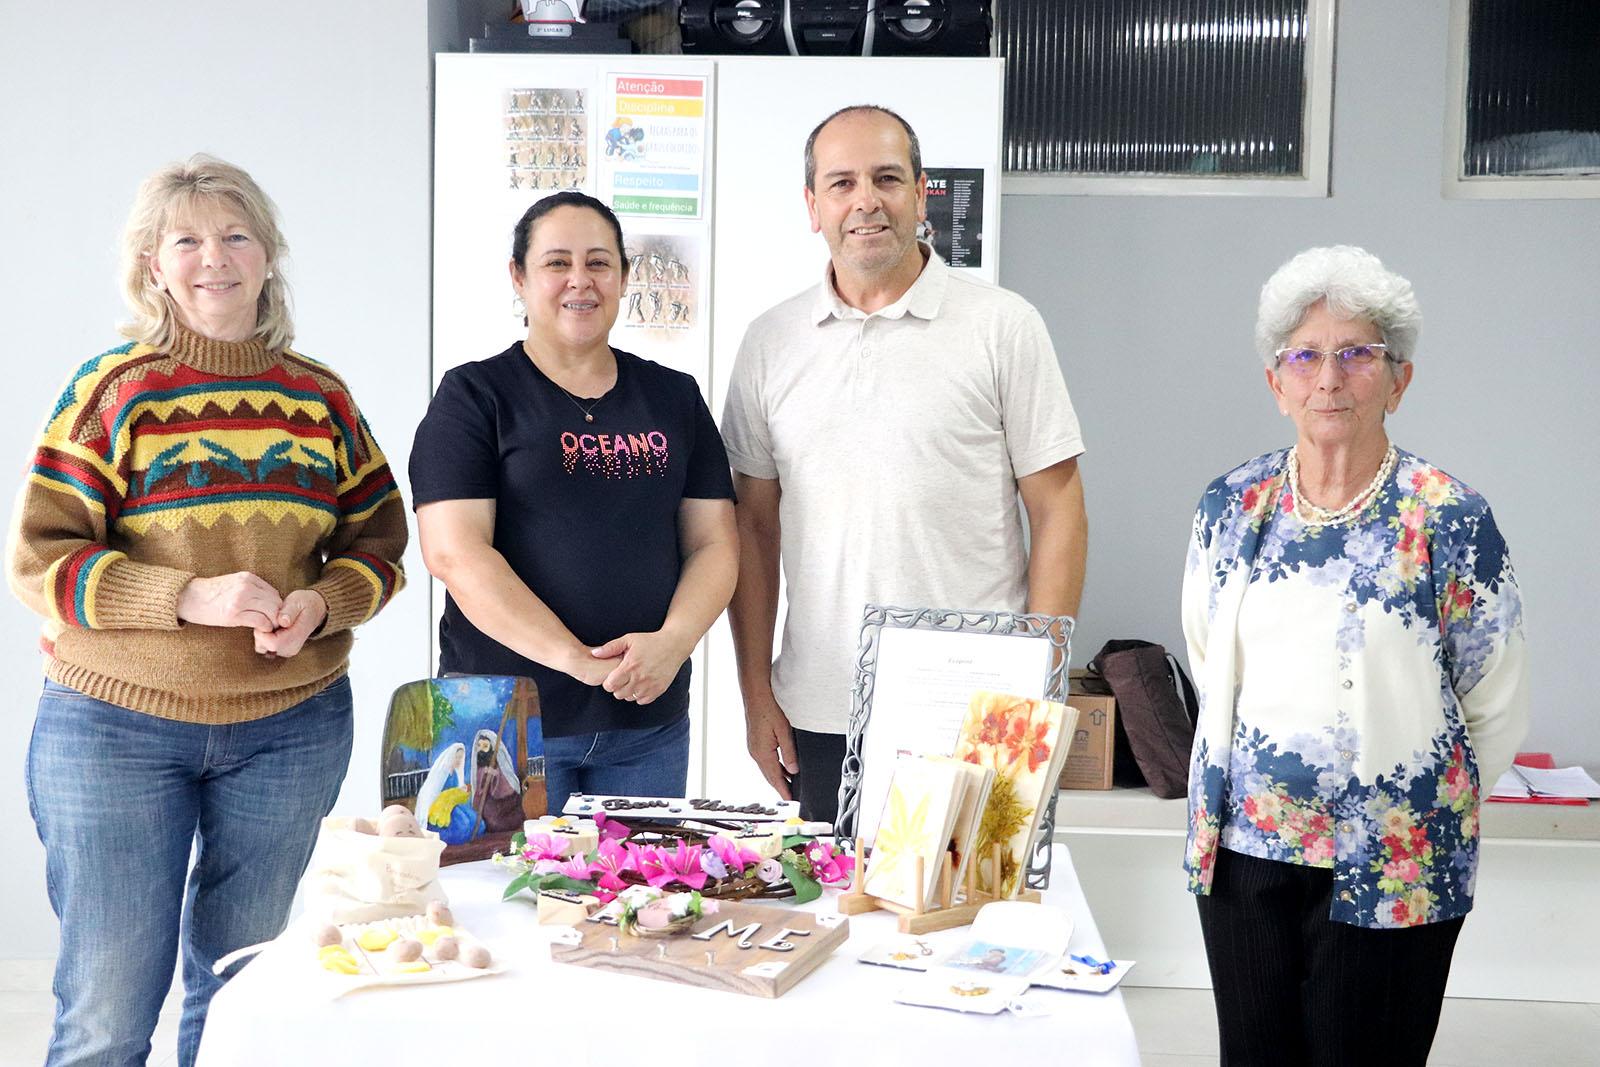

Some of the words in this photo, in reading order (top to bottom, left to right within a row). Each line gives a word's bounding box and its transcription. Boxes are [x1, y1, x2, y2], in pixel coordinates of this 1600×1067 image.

[616, 81, 665, 94] Atenção
[619, 100, 675, 114] Disciplina
[615, 175, 664, 189] Respeito
[926, 179, 947, 189] ATE
[614, 200, 640, 209] Saúde
[648, 202, 693, 213] frequência
[560, 431, 668, 457] OCEANO
